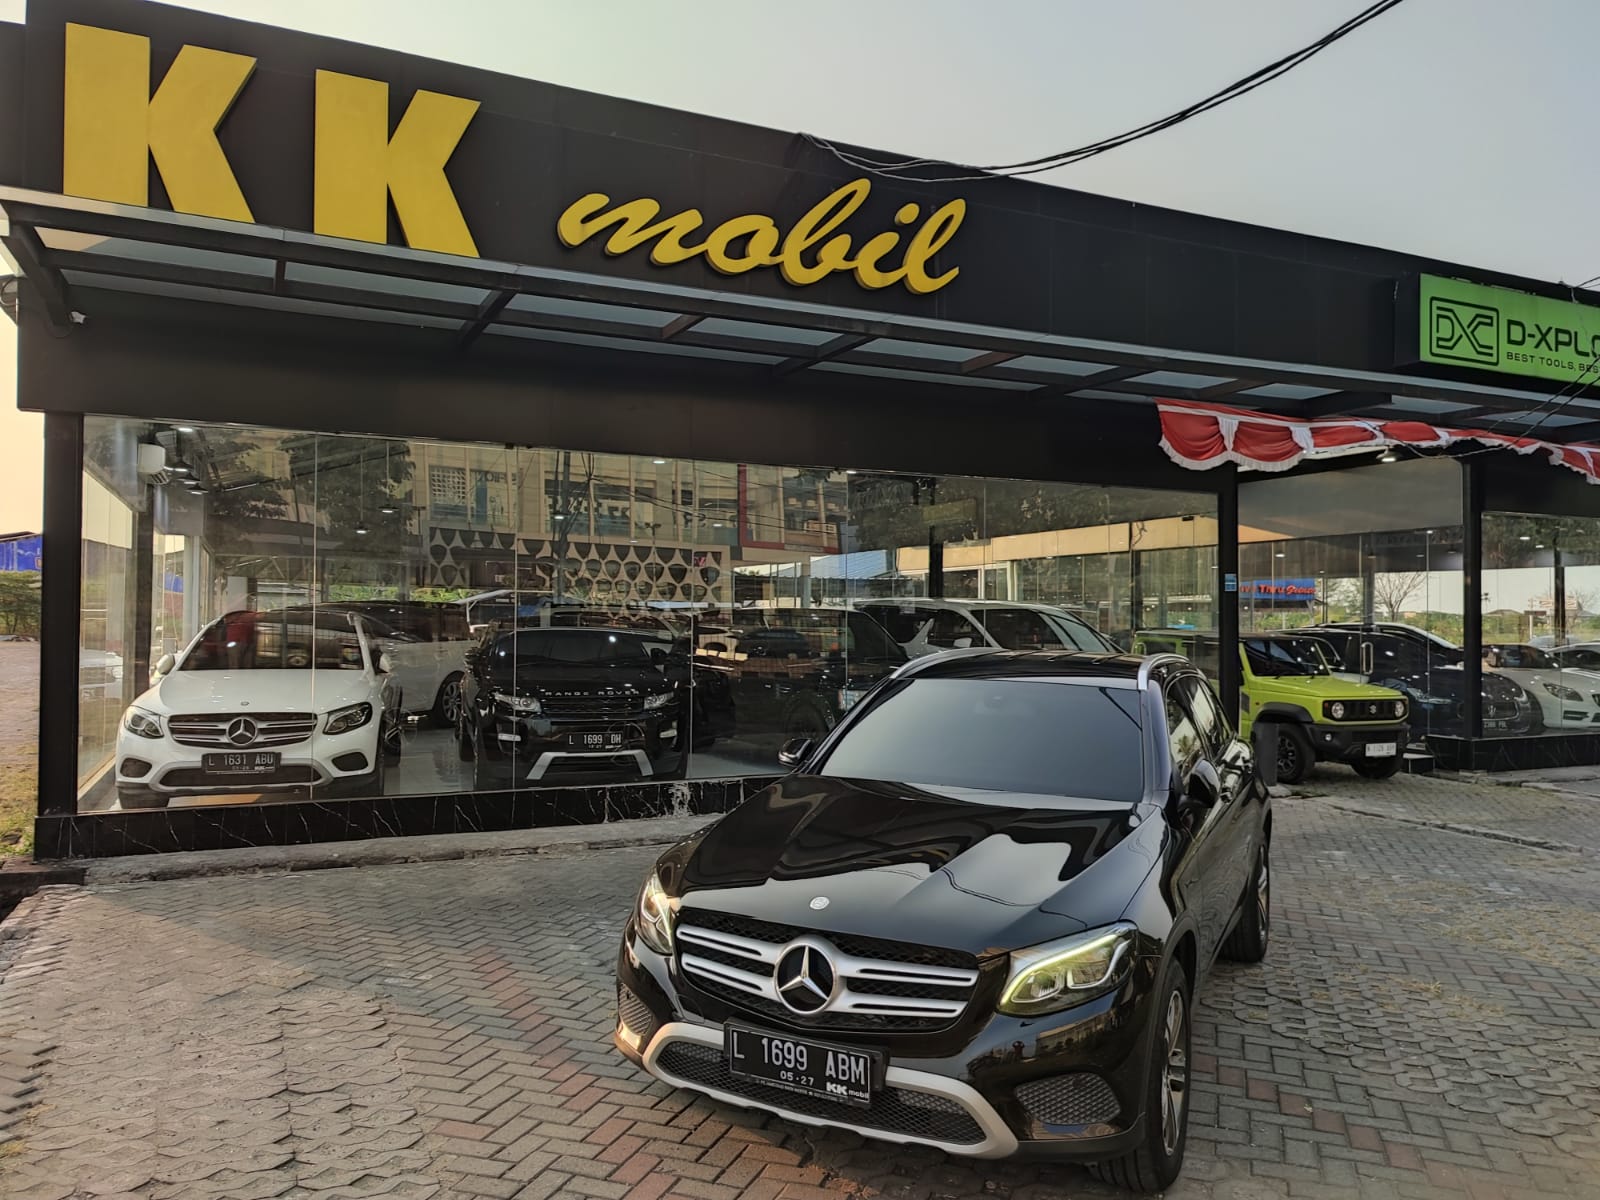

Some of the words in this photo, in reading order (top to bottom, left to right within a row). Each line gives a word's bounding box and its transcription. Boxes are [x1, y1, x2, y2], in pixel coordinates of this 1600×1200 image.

[557, 178, 967, 295] mobil
[1506, 351, 1535, 363] BEST
[1538, 356, 1577, 371] TOOLS,
[568, 734, 575, 745] L
[583, 734, 603, 745] 1699
[208, 755, 216, 766] L
[223, 753, 247, 766] 1631
[255, 752, 274, 765] ABU
[732, 1031, 745, 1060] L
[761, 1037, 808, 1072] 1699
[825, 1050, 866, 1086] ABM
[826, 1081, 849, 1097] KK
